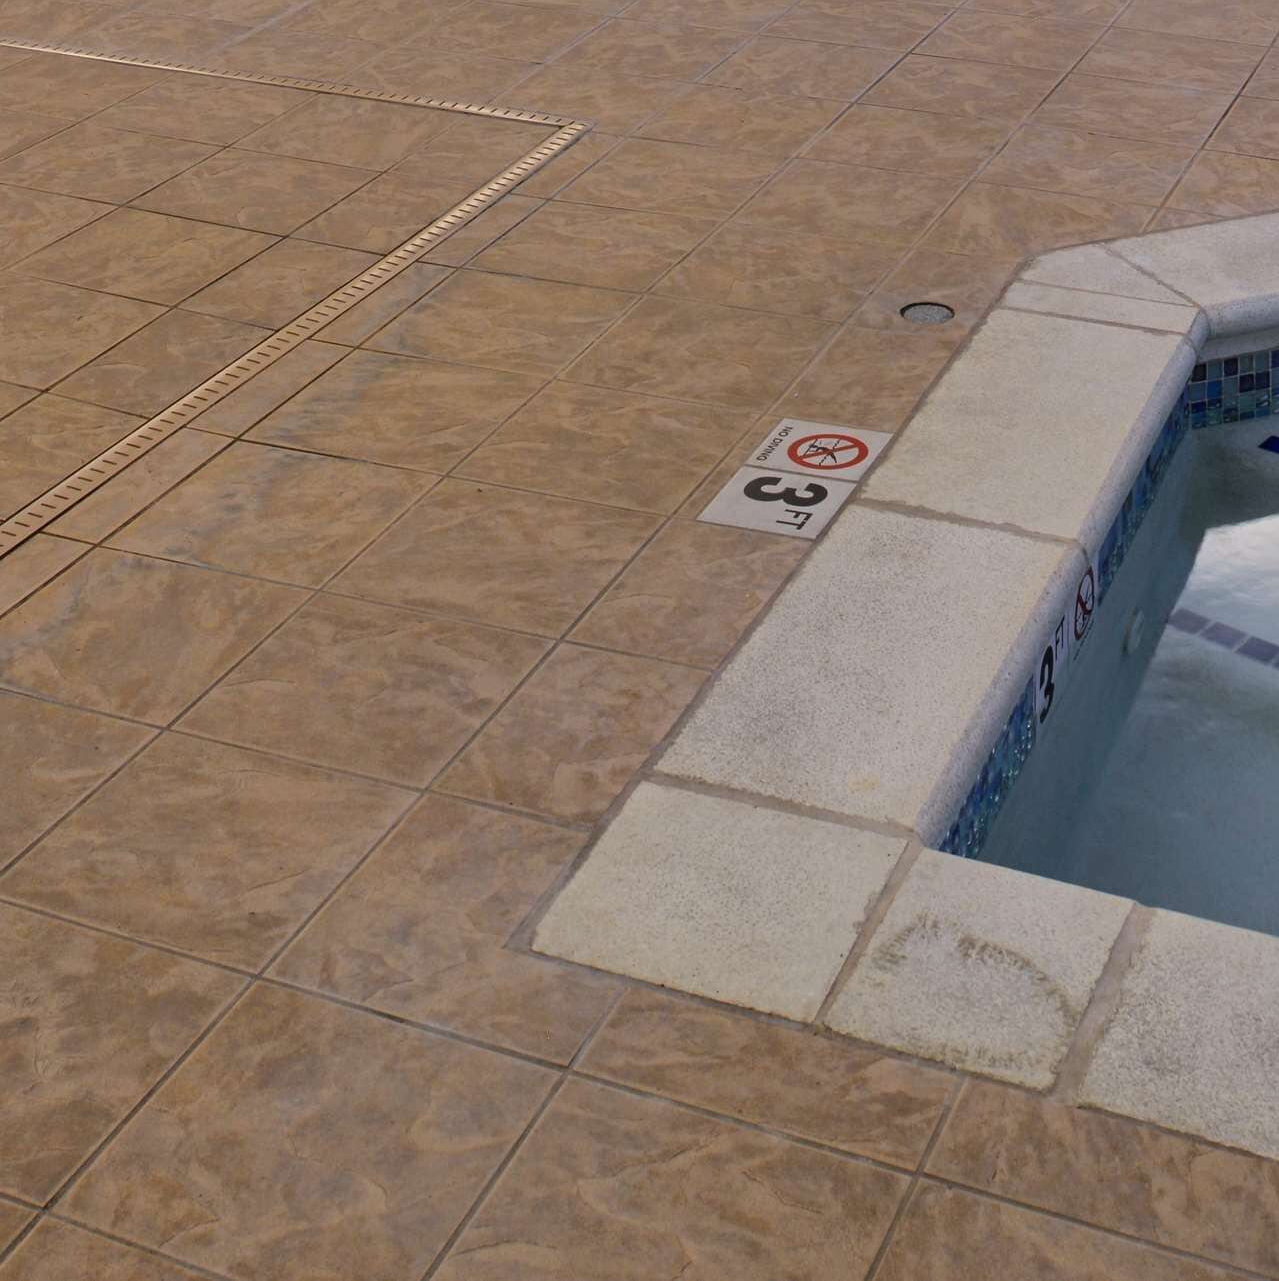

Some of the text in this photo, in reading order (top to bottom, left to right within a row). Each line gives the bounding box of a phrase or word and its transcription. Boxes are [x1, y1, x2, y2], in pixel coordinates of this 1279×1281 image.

[756, 425, 793, 461] NO DIVING
[743, 476, 828, 531] 3 FT
[1039, 614, 1066, 723] 3 FT
